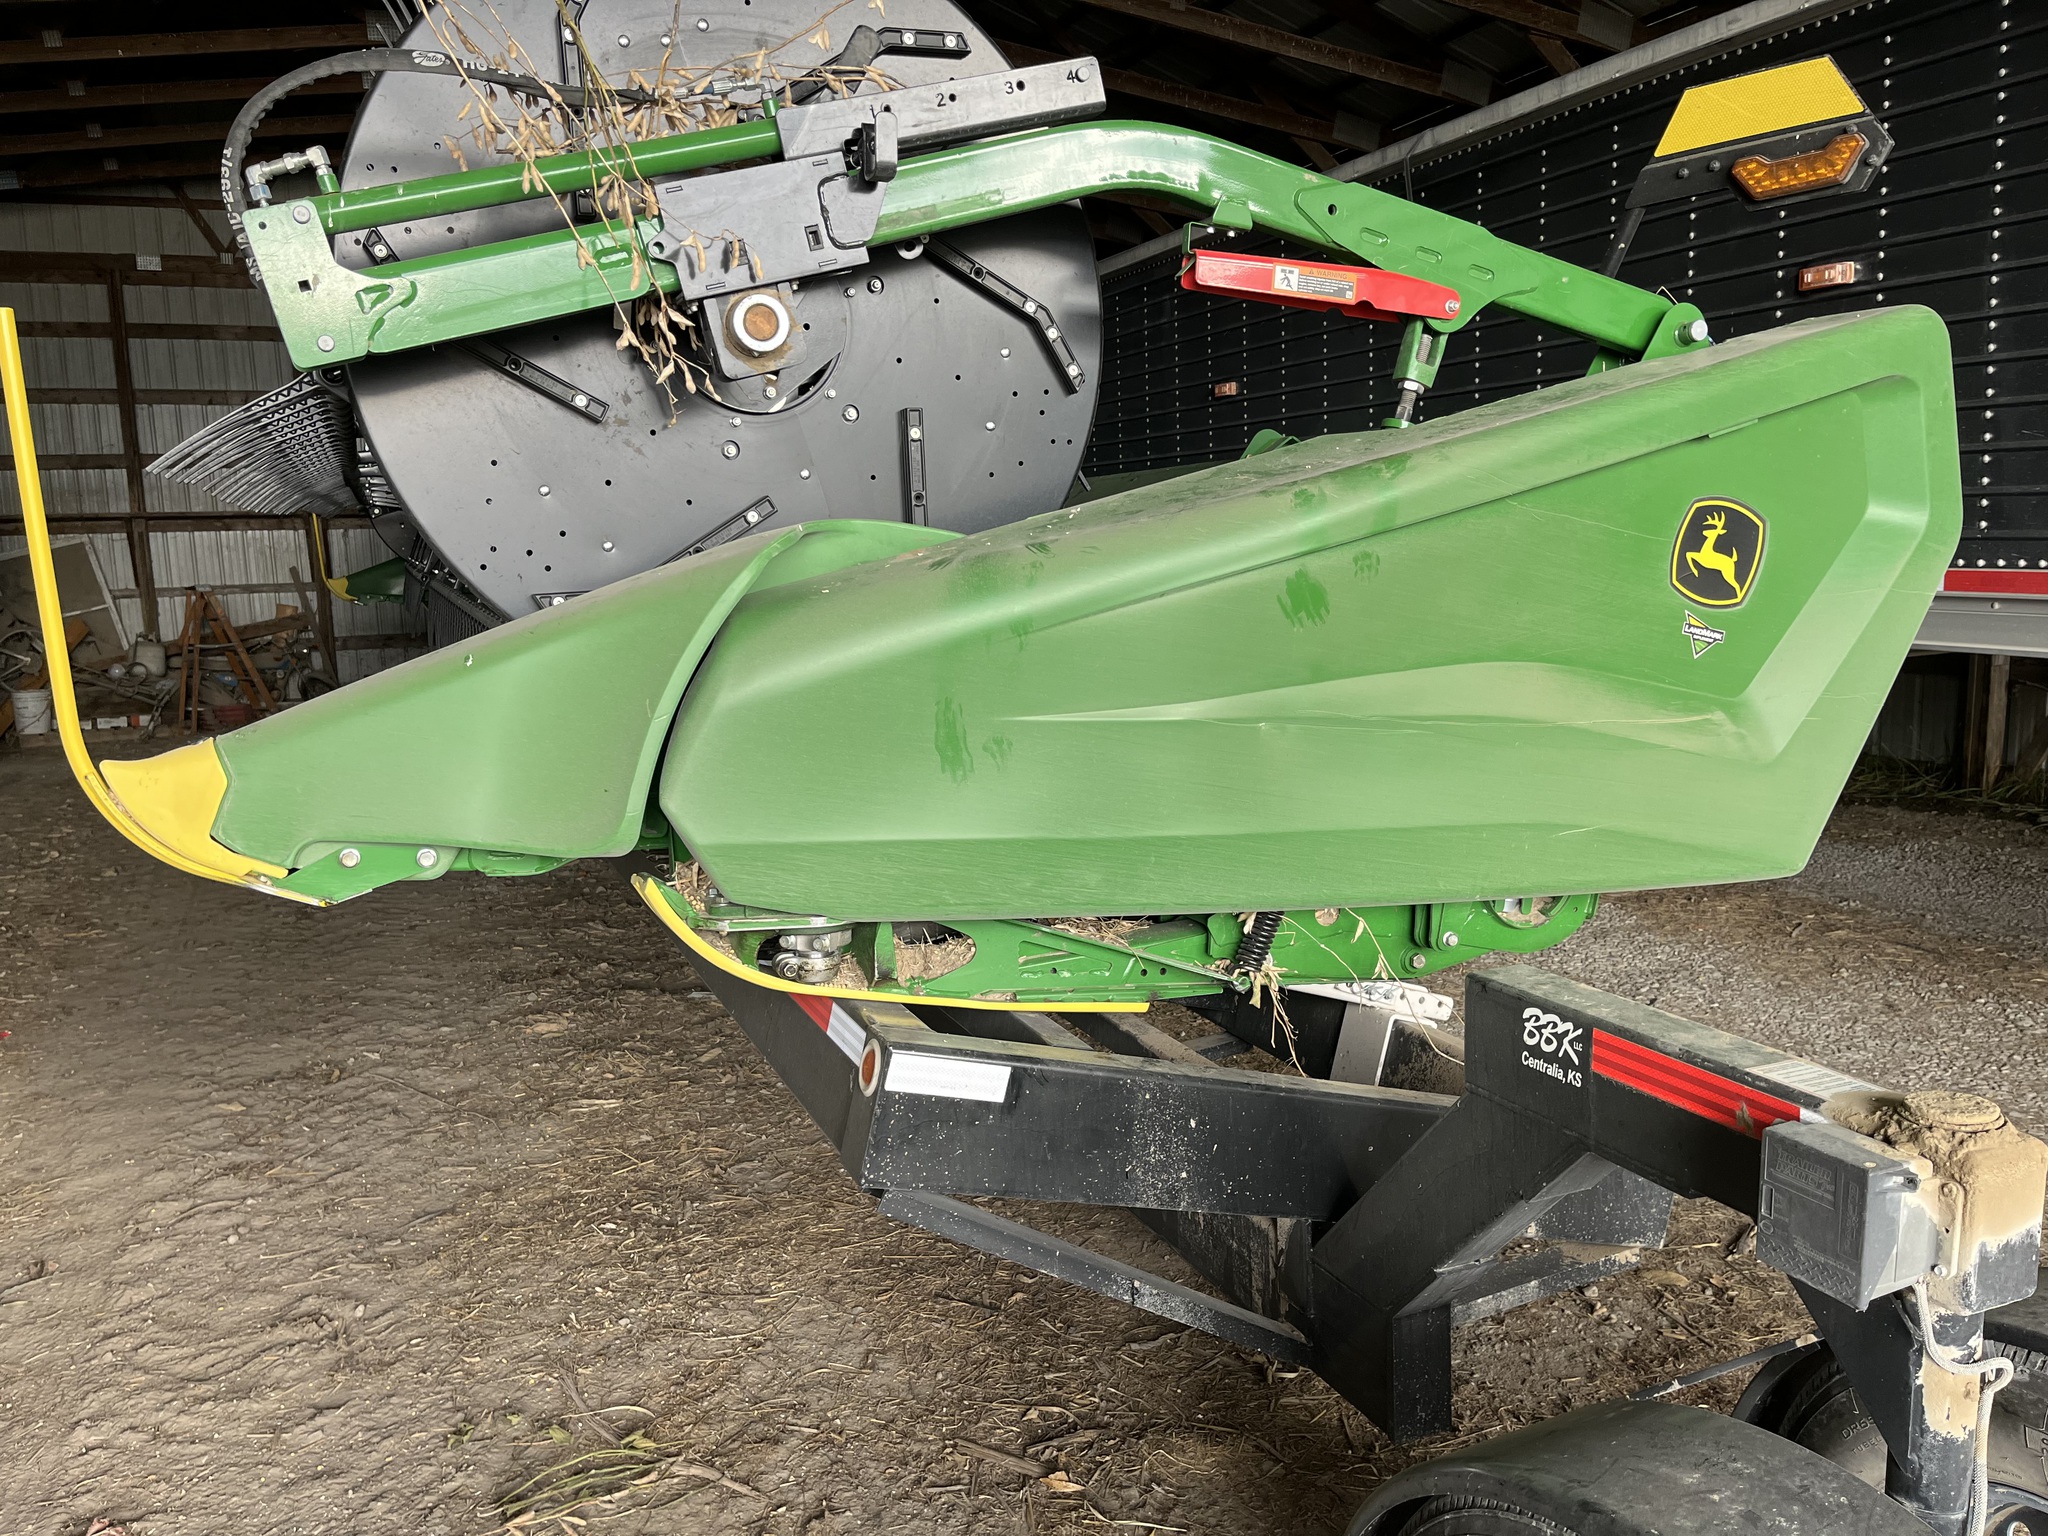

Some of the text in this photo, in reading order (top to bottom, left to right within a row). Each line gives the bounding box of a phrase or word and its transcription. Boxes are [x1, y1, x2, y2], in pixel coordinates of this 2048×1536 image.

[412, 52, 446, 65] Gates
[936, 92, 946, 107] 2
[1004, 80, 1015, 95] 3
[1066, 69, 1077, 83] 4
[1317, 270, 1348, 280] WARNING
[1522, 1007, 1583, 1066] BBK LLC
[1521, 1051, 1583, 1088] Centralia, KS
